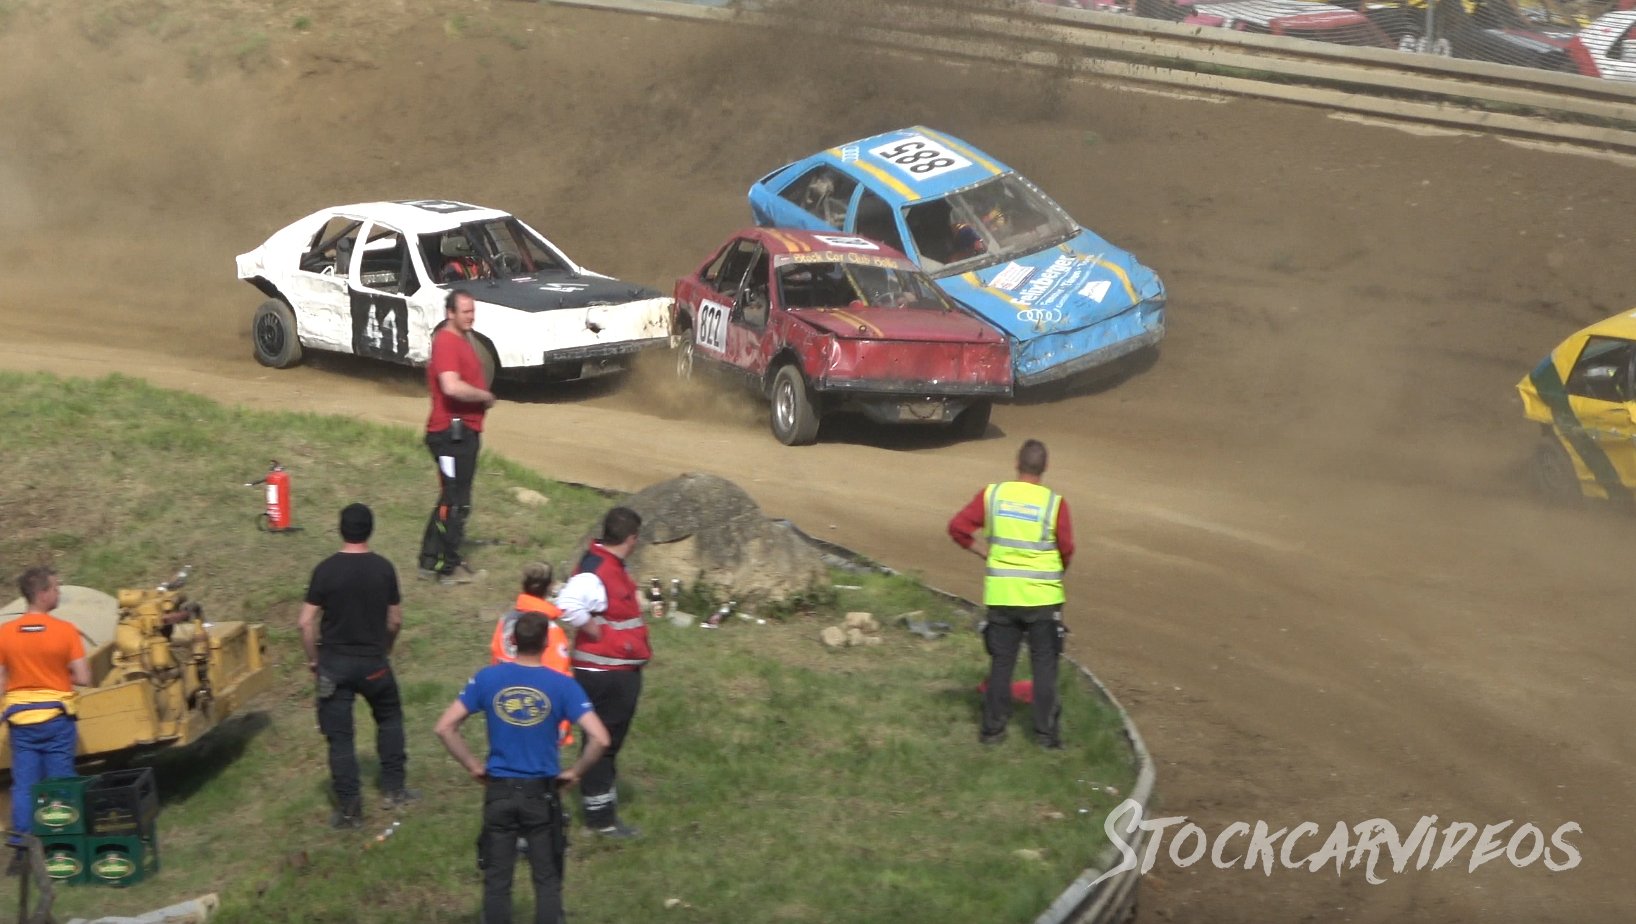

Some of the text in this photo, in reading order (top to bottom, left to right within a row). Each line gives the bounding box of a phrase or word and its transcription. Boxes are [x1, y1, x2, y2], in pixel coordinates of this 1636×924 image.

[879, 141, 956, 174] 885
[825, 250, 844, 262] Car
[366, 303, 399, 354] 41
[700, 304, 722, 348] 822
